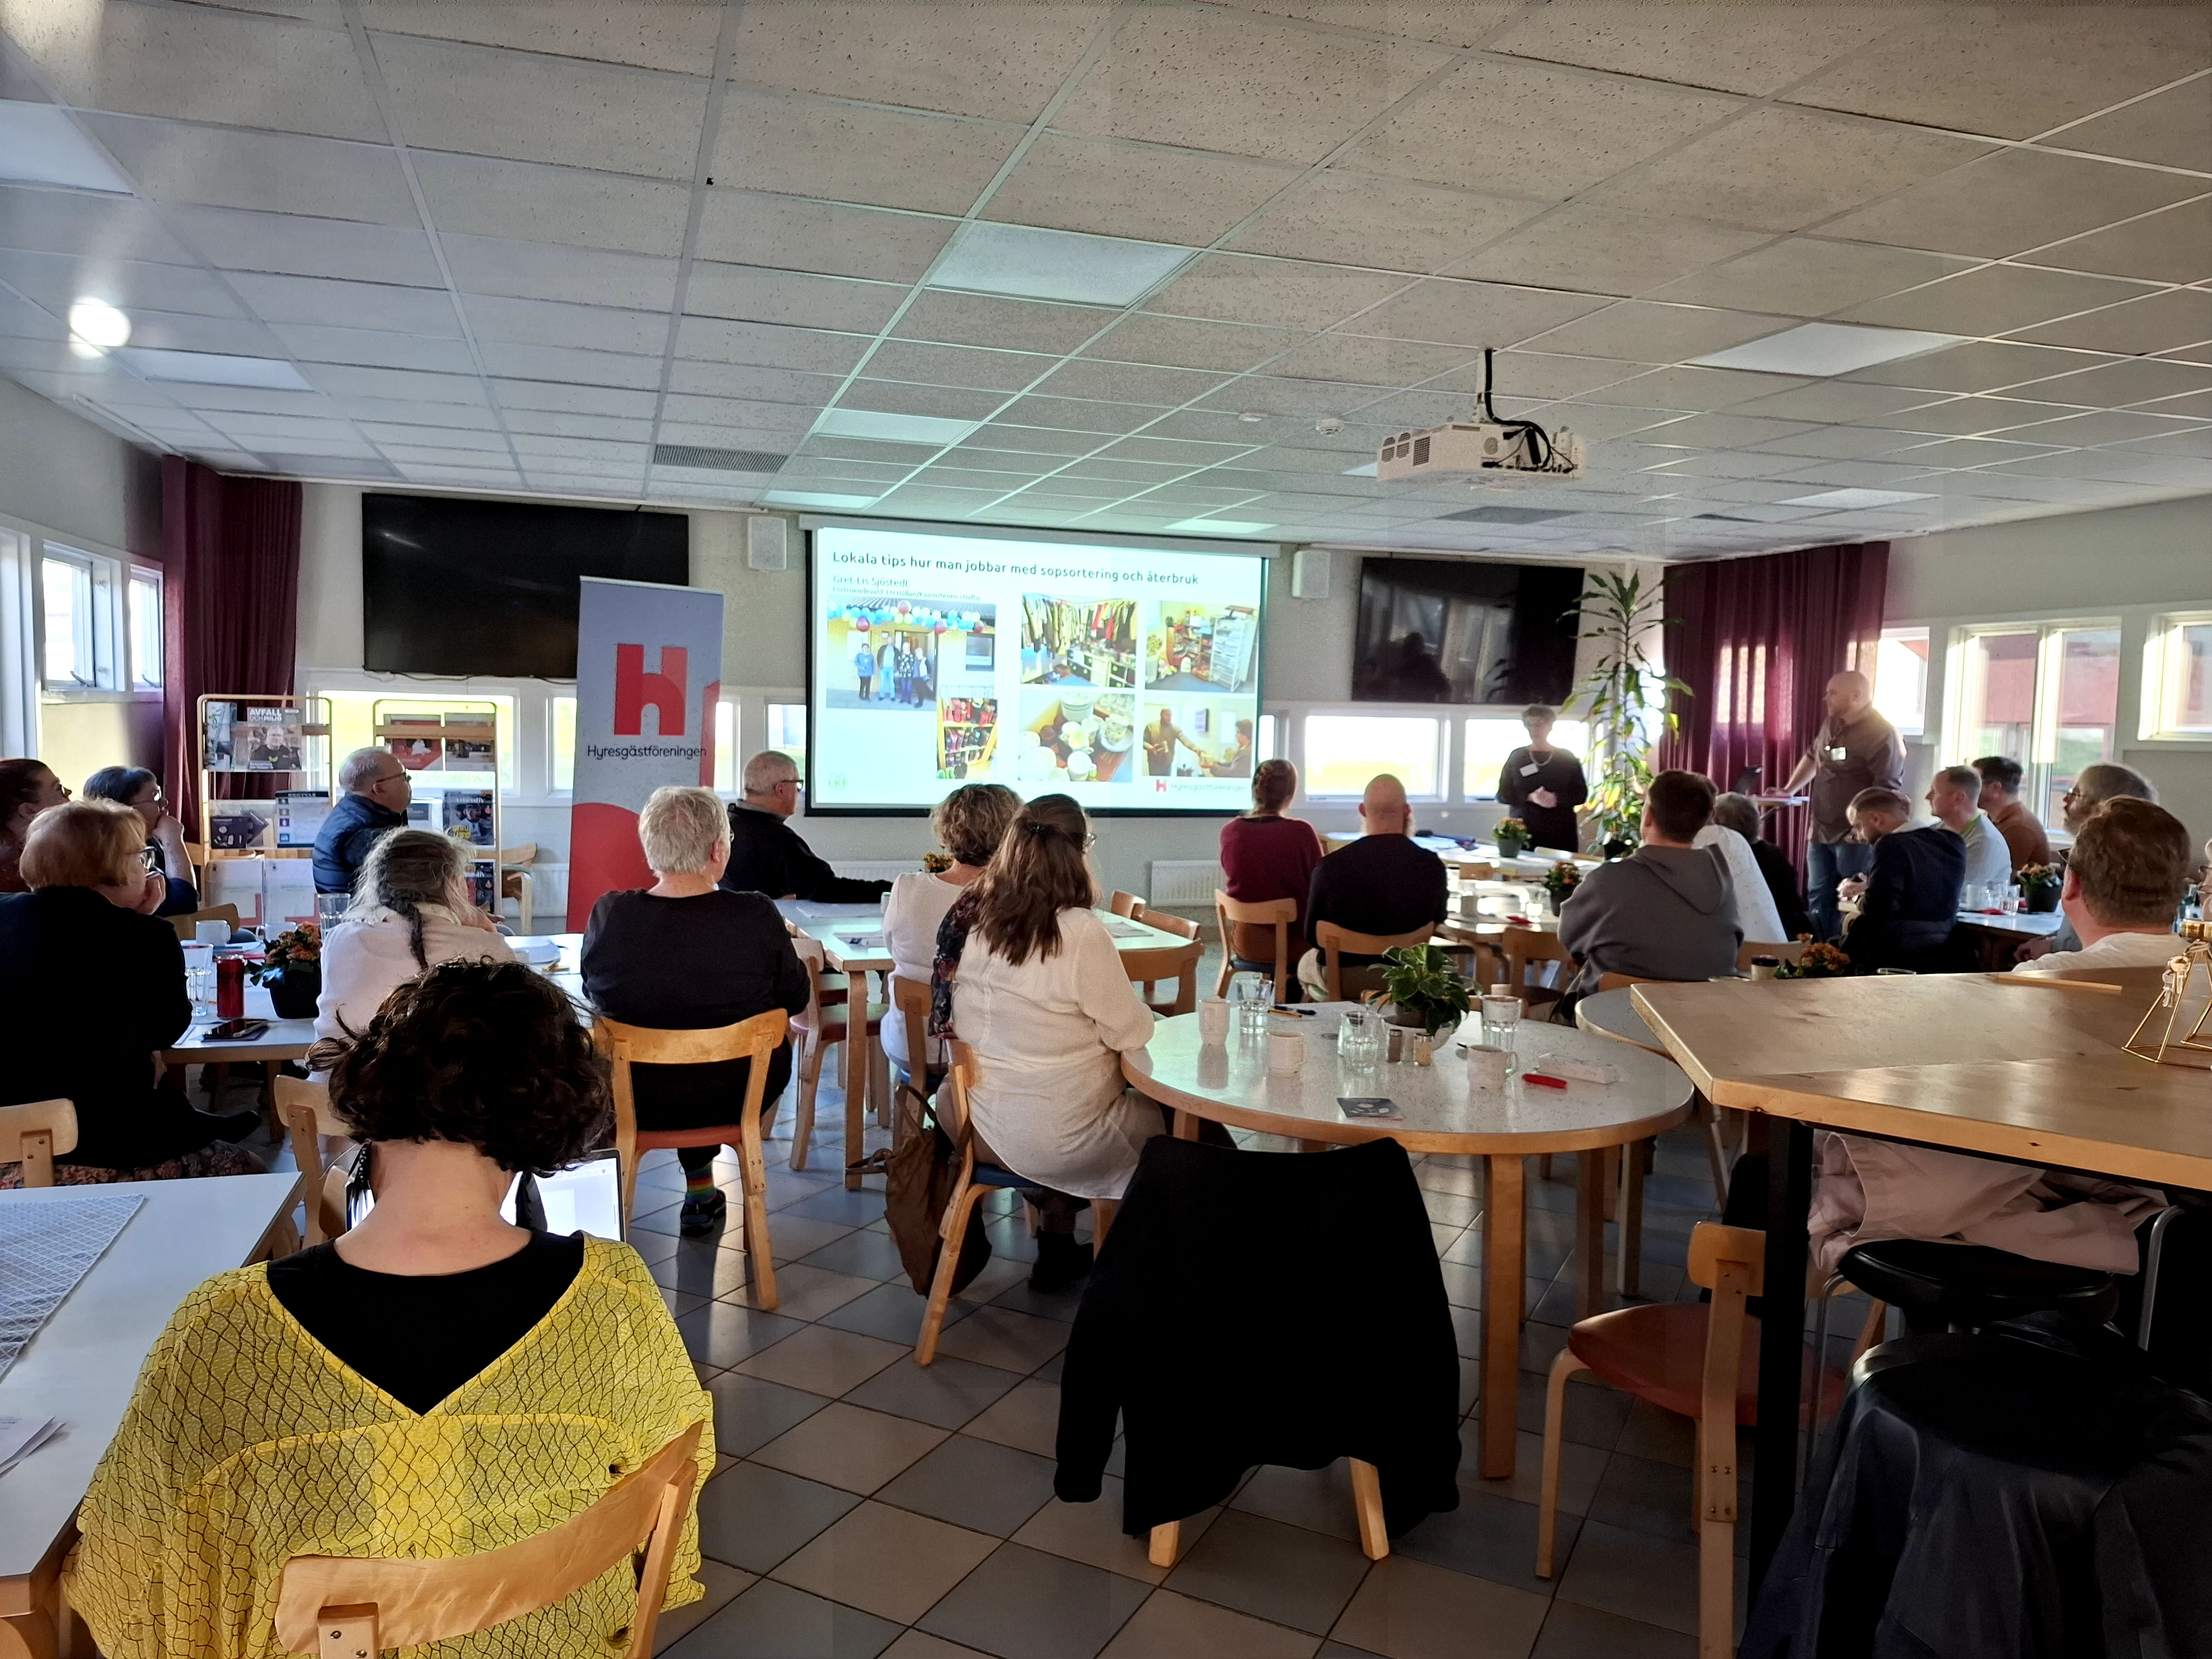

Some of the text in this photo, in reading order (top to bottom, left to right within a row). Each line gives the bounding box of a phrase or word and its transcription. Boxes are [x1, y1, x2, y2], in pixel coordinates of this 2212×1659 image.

[833, 551, 1199, 584] Lokala tips hur man jobbar med sopsortering och återbruk
[872, 577, 909, 587] Sjöstedt
[587, 744, 707, 761] Hyresgästföreningen
